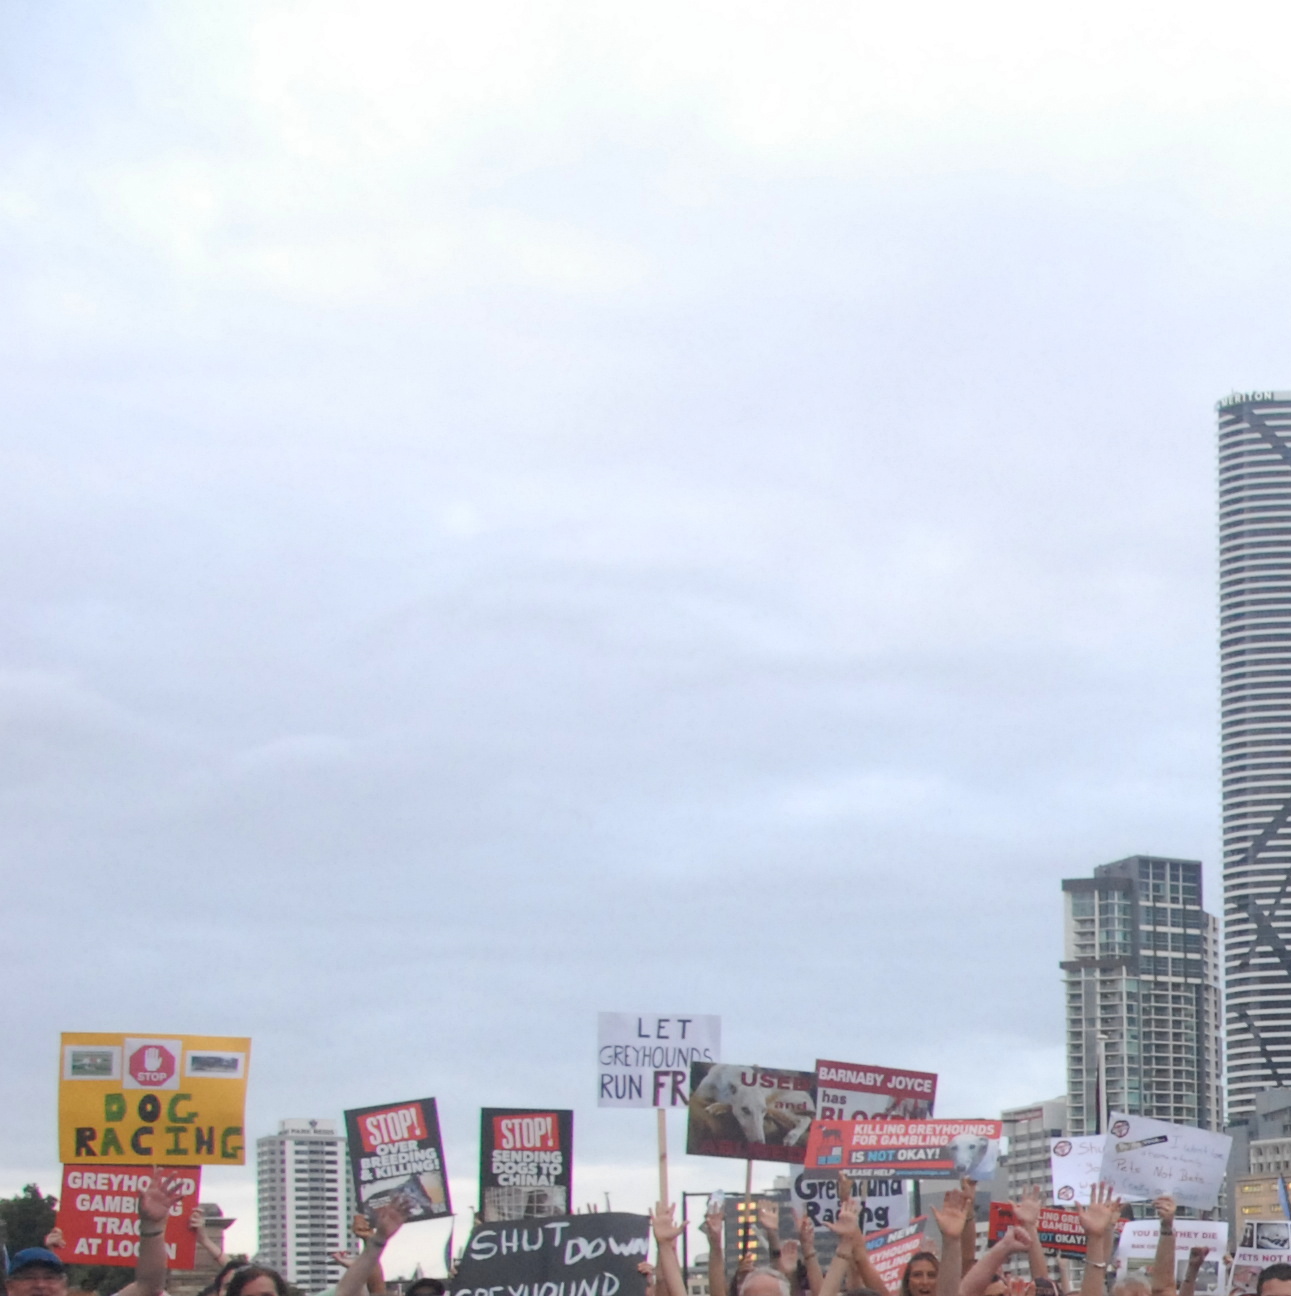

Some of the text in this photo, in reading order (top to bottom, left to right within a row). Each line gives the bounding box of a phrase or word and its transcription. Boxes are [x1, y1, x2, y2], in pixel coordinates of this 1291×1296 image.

[637, 1017, 693, 1039] LET
[600, 1046, 713, 1069] GREYHOUNDS
[137, 1072, 167, 1082] STOP
[741, 1071, 811, 1092] USED
[819, 1066, 933, 1093] BARNABY JOYCE
[600, 1073, 643, 1100] RUN
[774, 1101, 807, 1112] and
[821, 1090, 847, 1105] has
[104, 1093, 198, 1124] DOG
[366, 1107, 421, 1146] STOP!
[501, 1117, 553, 1149] STOP!
[853, 1124, 995, 1136] KILLING GREYHOUNDS
[74, 1126, 244, 1159] RACING
[376, 1140, 418, 1157] OVER
[852, 1135, 949, 1146] FOR GAMBLING
[360, 1148, 437, 1169] BREEDING
[492, 1151, 562, 1163] SENDING
[851, 1148, 940, 1163] IS NOT OKAY!
[360, 1158, 440, 1182] & KILLING!
[492, 1163, 562, 1174] DOGS TO
[498, 1174, 556, 1187] CHINA!
[470, 1221, 649, 1266] SHUT DOWN
[866, 1224, 918, 1250] NO NEW
[1055, 1235, 1087, 1246] OKAY!
[1132, 1231, 1150, 1239] YOU
[1202, 1231, 1218, 1240] DIE
[74, 1238, 102, 1256] AT
[1238, 1253, 1259, 1261] PETS
[1262, 1254, 1284, 1262] NOT
